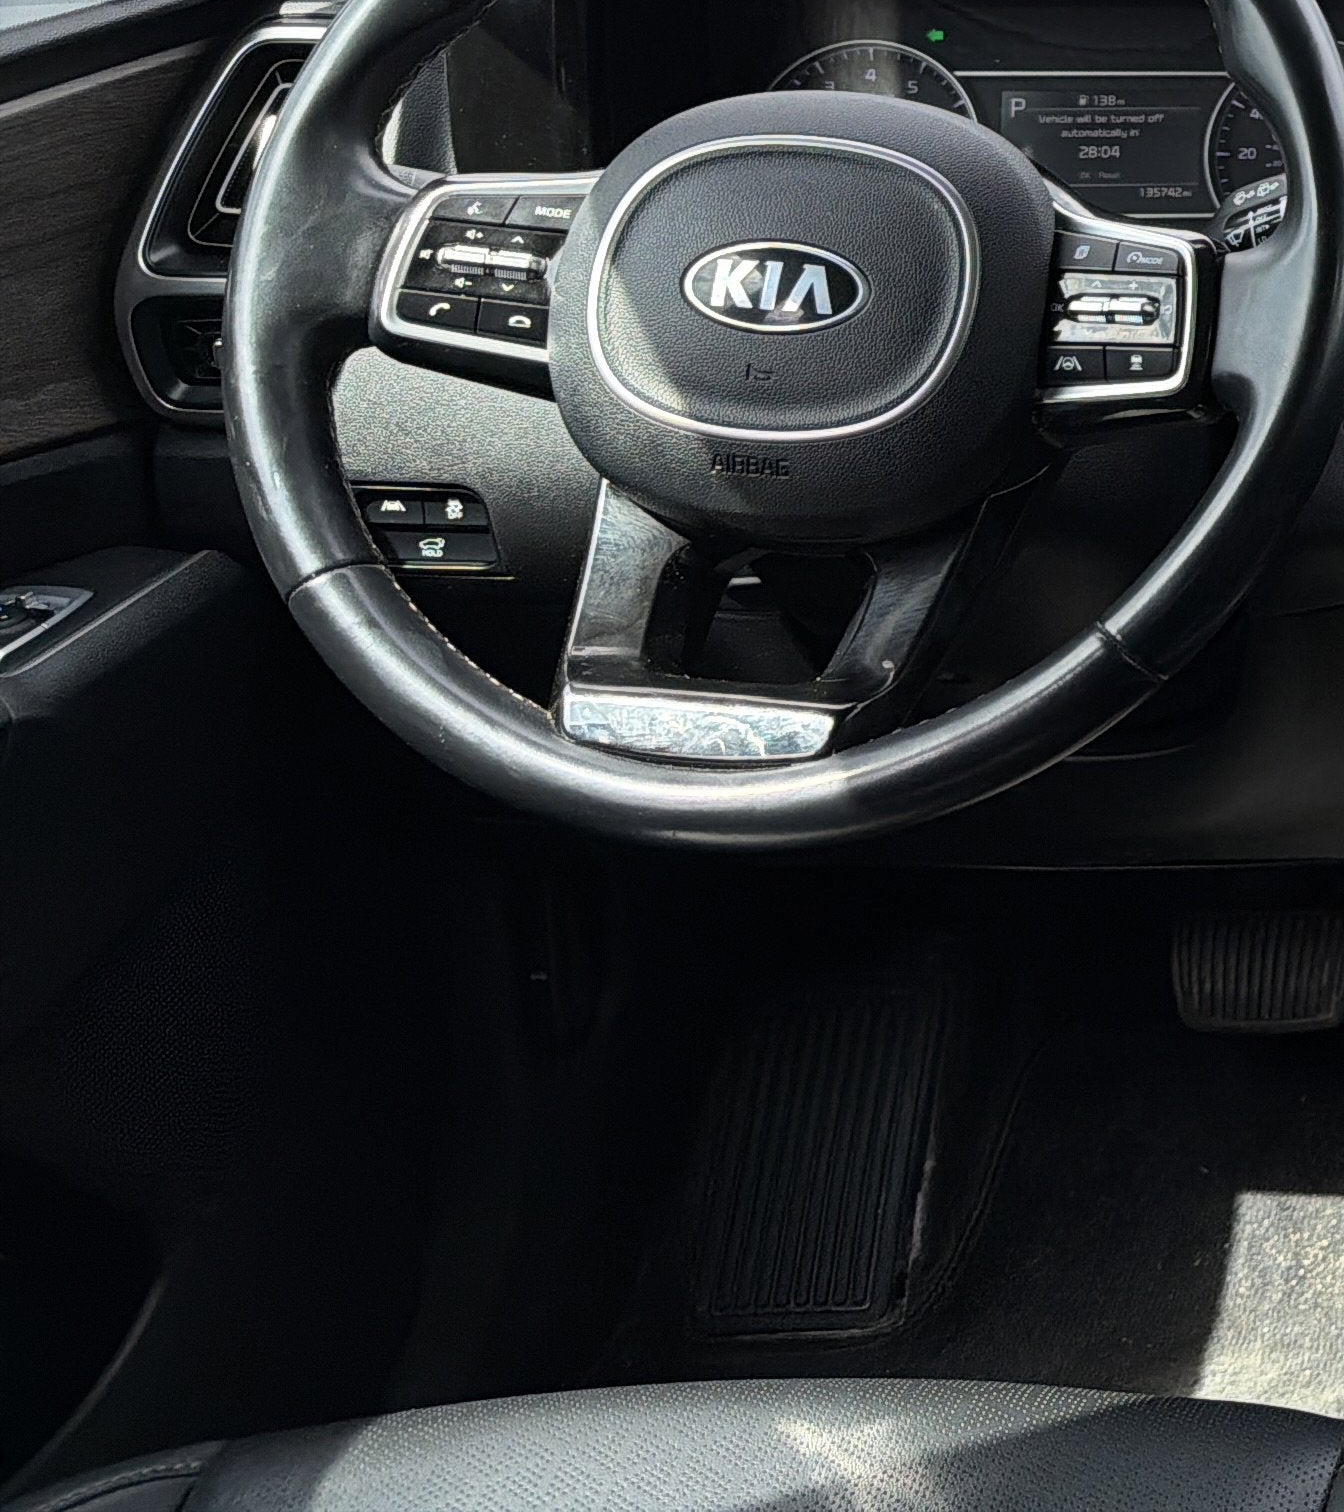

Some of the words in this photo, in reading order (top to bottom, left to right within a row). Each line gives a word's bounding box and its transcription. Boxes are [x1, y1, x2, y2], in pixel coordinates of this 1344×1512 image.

[865, 68, 877, 82] 4
[907, 80, 919, 94] 5
[1010, 97, 1026, 118] P
[1250, 108, 1264, 120] 4
[1038, 114, 1074, 124] Vehicle
[1076, 114, 1091, 124] will
[1094, 114, 1107, 124] be
[1110, 114, 1145, 123] turned
[1147, 113, 1165, 123] off
[1061, 128, 1128, 139] automatically
[1079, 145, 1121, 159] 28:04
[1238, 147, 1257, 160] 20
[534, 205, 573, 219] MODE
[710, 257, 833, 315] KIA
